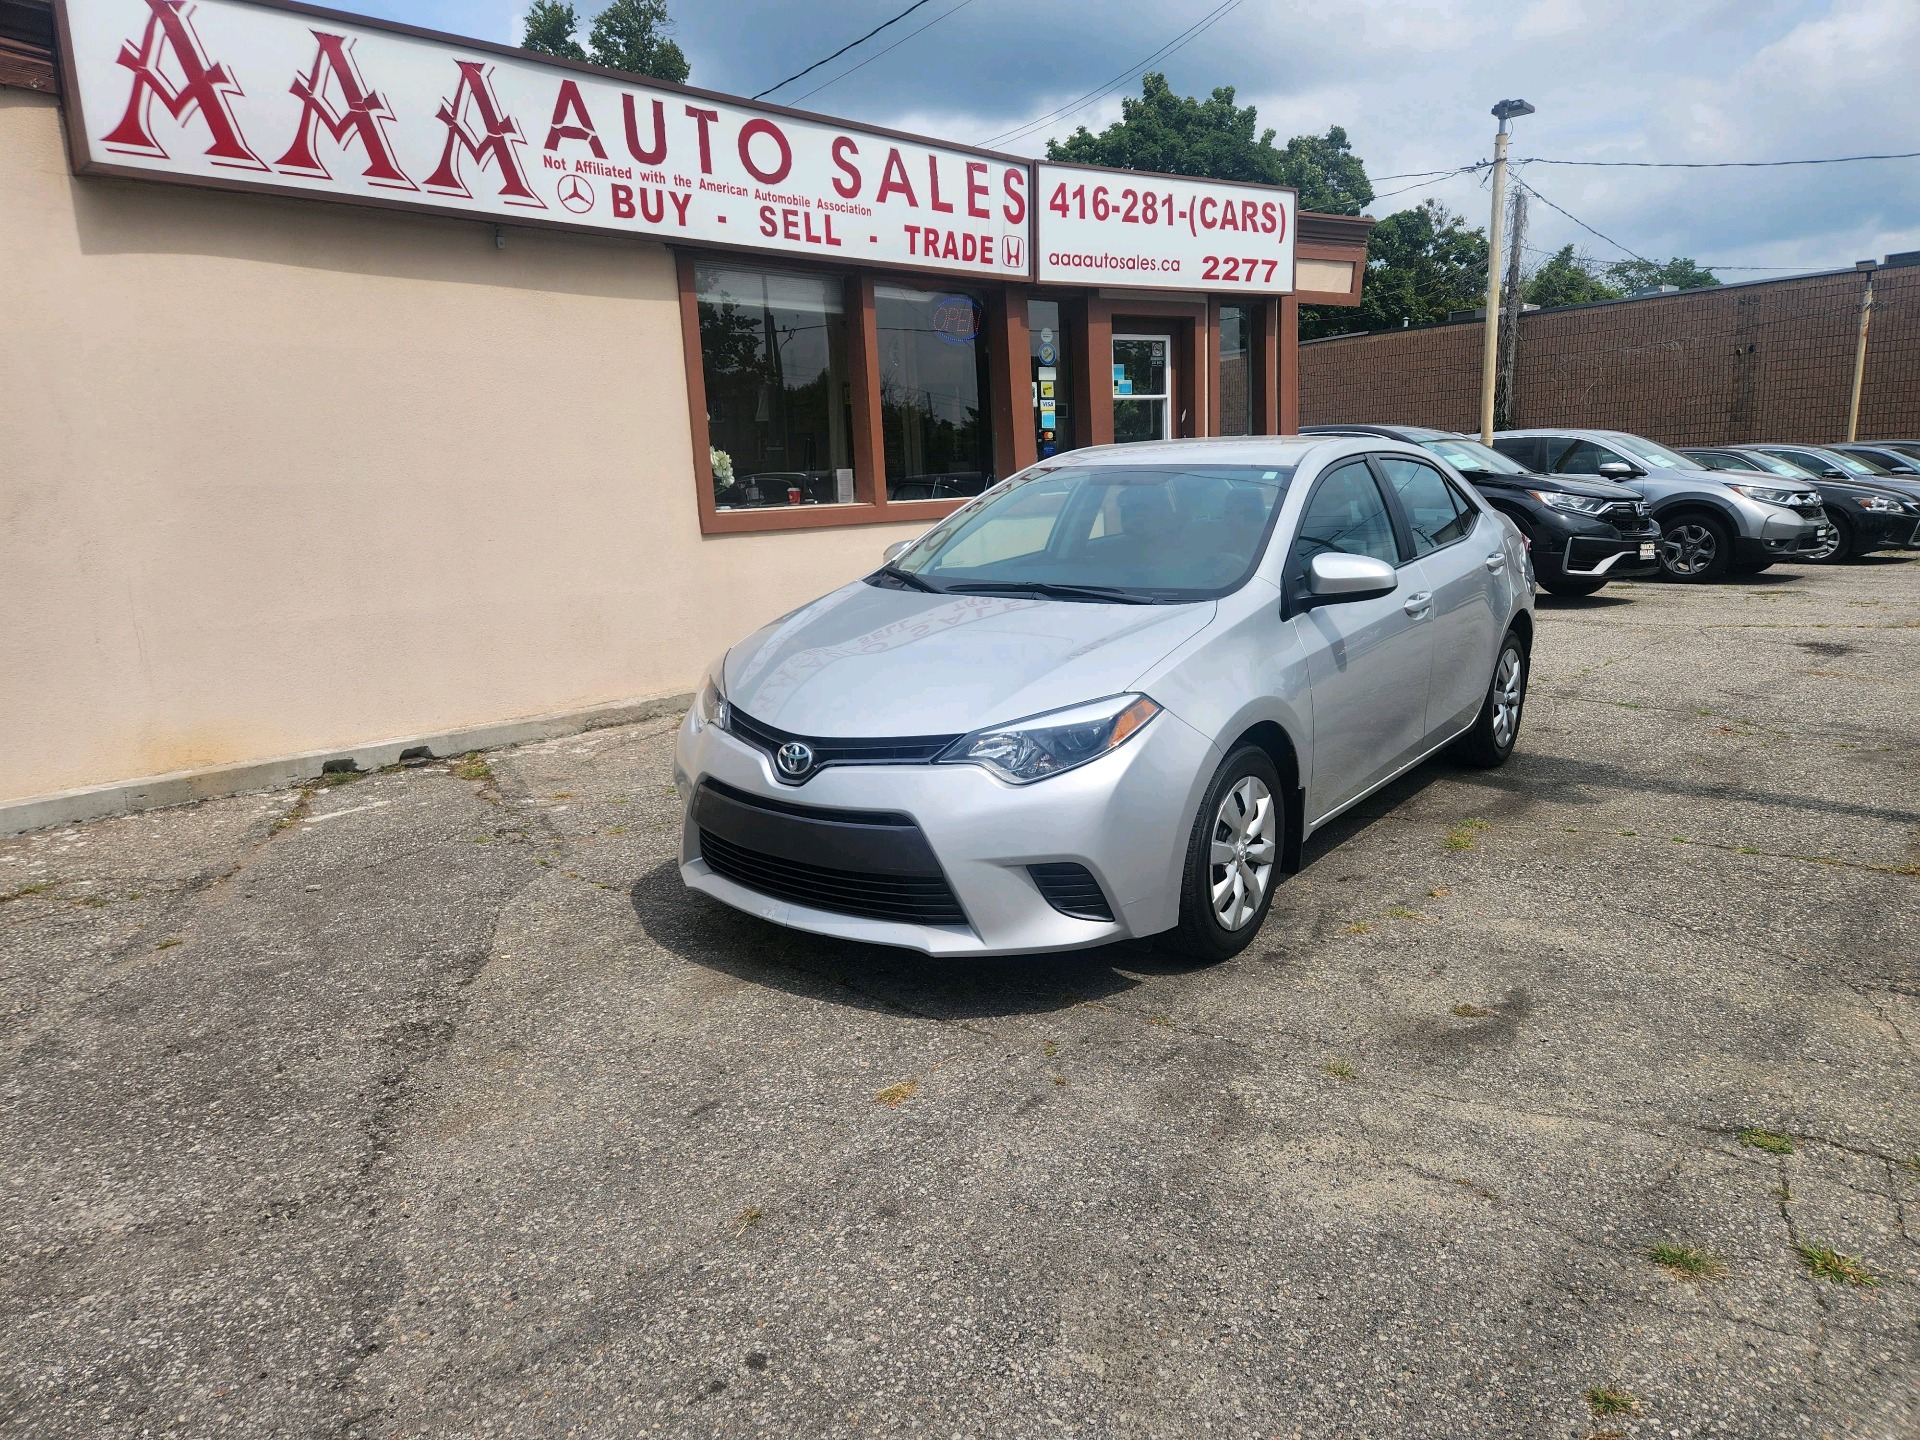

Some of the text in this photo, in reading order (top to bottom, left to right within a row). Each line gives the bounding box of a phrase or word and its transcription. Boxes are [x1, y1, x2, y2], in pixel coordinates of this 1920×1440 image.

[543, 79, 793, 185] AUTO
[831, 136, 1026, 226] SALES
[543, 154, 872, 217] Not Affiliated with the American Automobile Association
[1049, 181, 1287, 244] 416-281-(CARS)
[611, 183, 693, 227] BUY
[759, 205, 842, 247] SELL
[904, 224, 994, 266] TRADE
[1048, 251, 1279, 283] aaaautosales.ca 2277
[933, 306, 982, 332] OPEN
